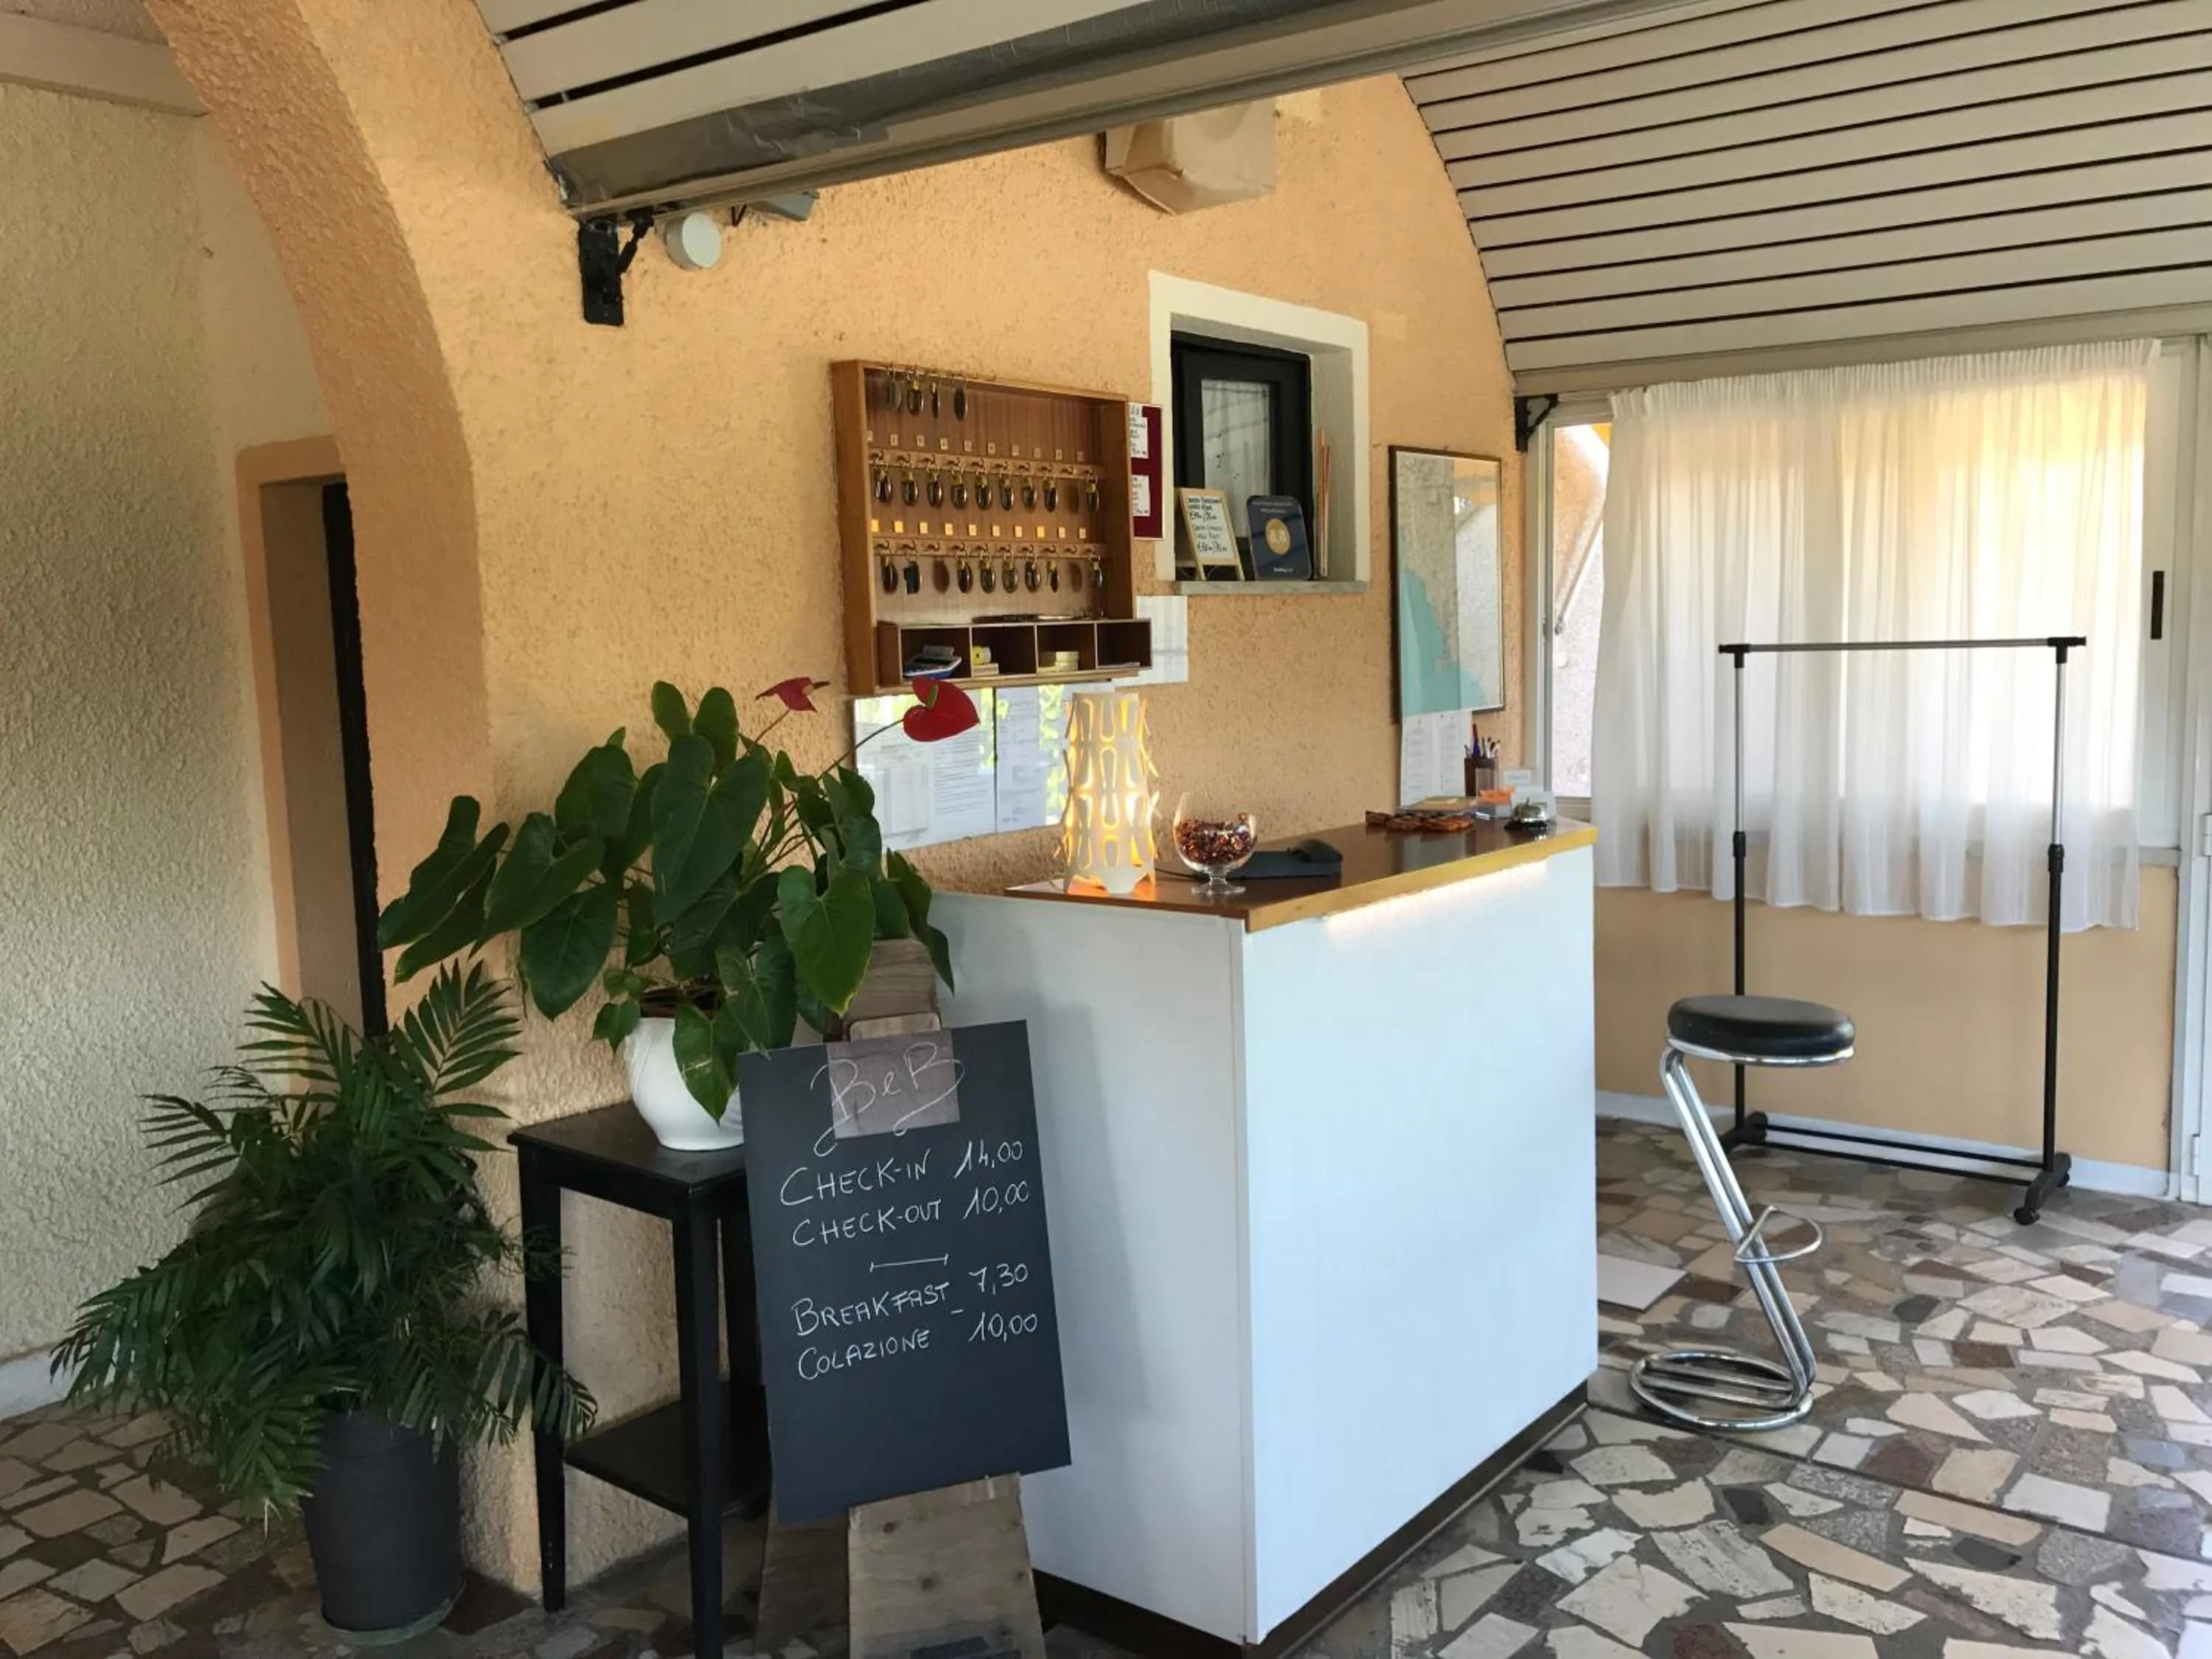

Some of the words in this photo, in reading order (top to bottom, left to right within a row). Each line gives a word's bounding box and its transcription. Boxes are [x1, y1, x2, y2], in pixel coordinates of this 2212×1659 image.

[780, 1148, 931, 1206] CHECK-IN
[954, 1139, 1023, 1179] 14,00
[793, 1198, 942, 1246] CHECK-OUT
[963, 1180, 1029, 1220] 10,00
[791, 1281, 950, 1337] BREAKFAST
[968, 1263, 1029, 1295] 7,30
[799, 1329, 931, 1380] COLAZIONE
[967, 1311, 1038, 1343] 10,00
